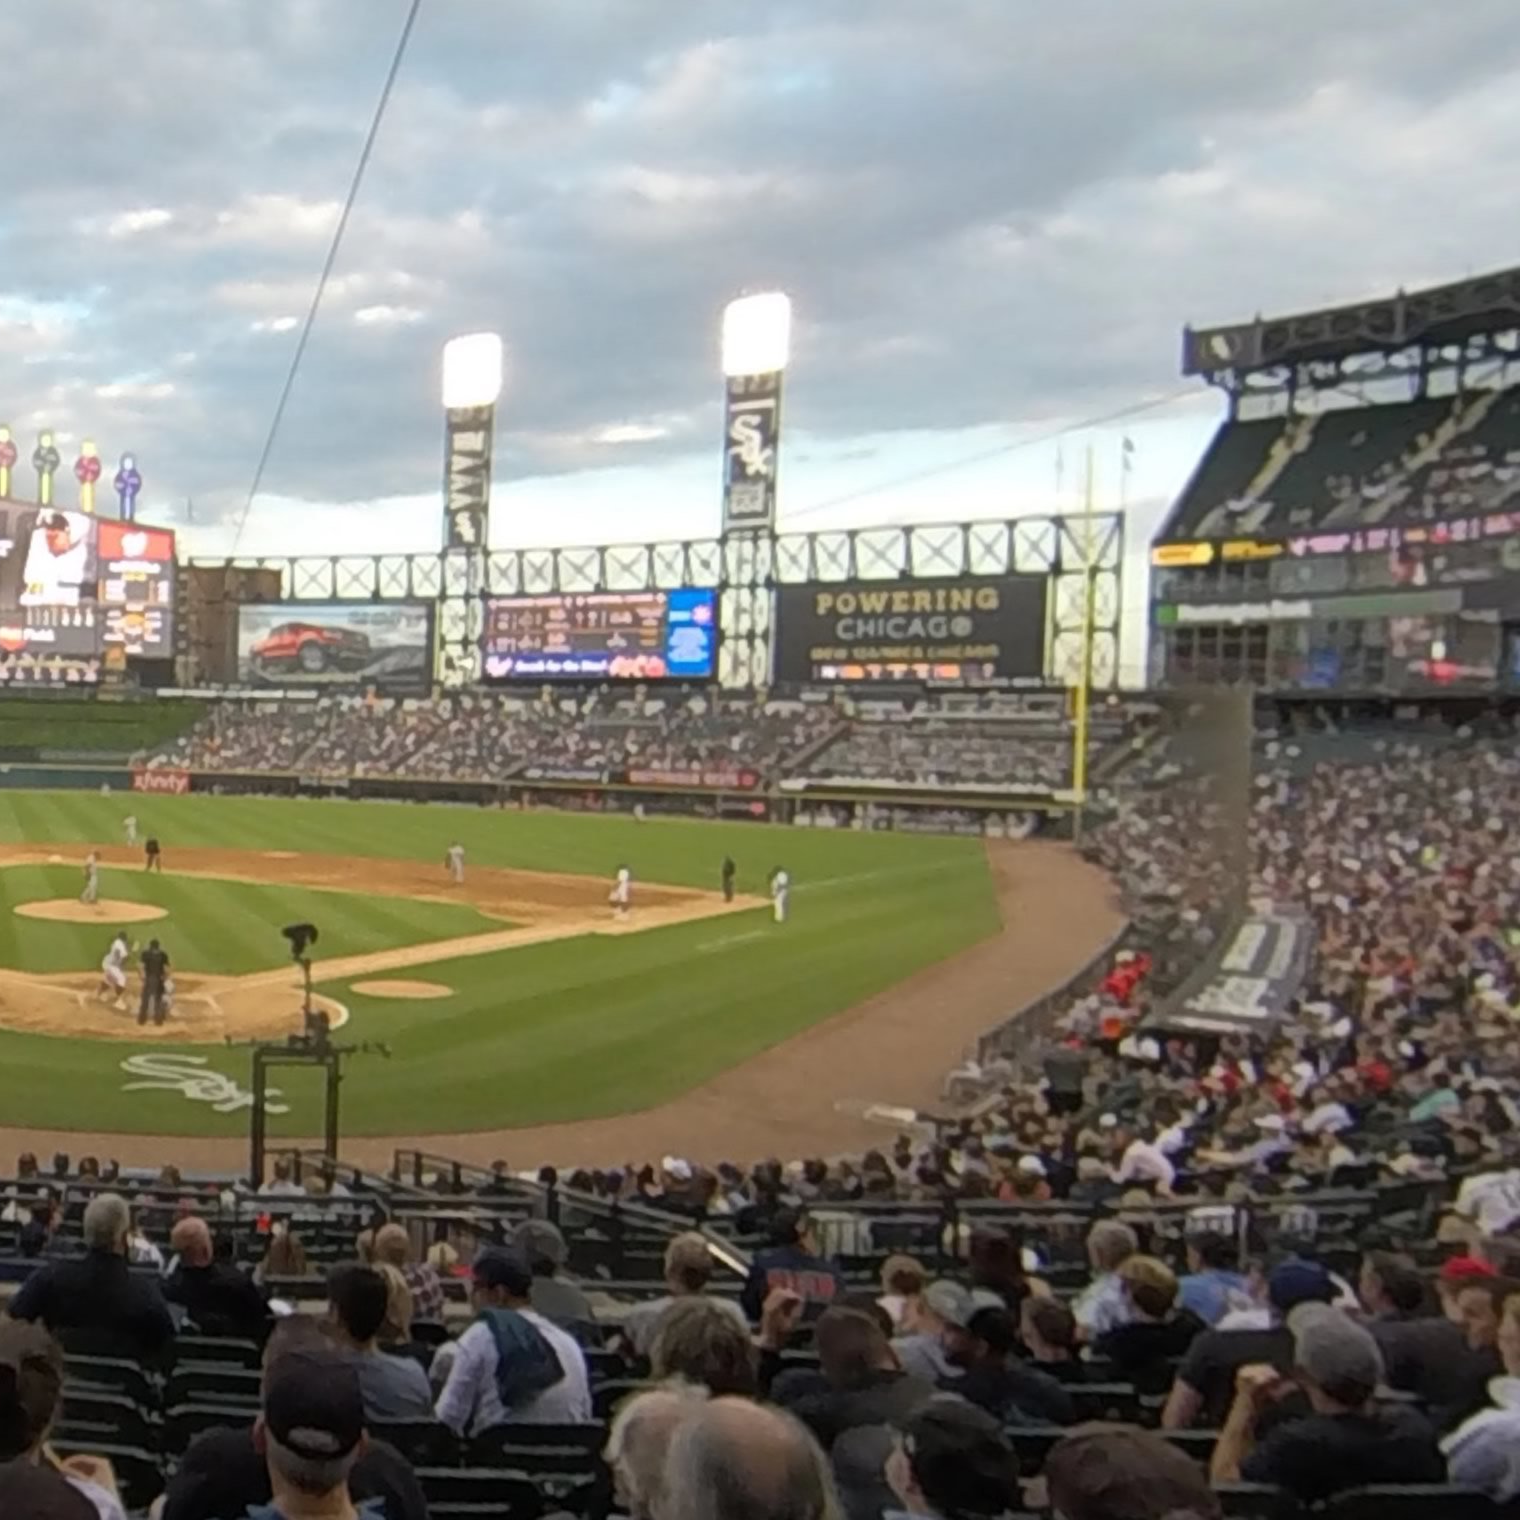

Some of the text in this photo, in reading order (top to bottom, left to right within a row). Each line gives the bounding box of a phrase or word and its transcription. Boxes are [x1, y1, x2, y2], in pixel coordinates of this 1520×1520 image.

[816, 587, 999, 615] POWERING
[836, 616, 973, 640] CHICAGO
[133, 773, 187, 795] xfinity
